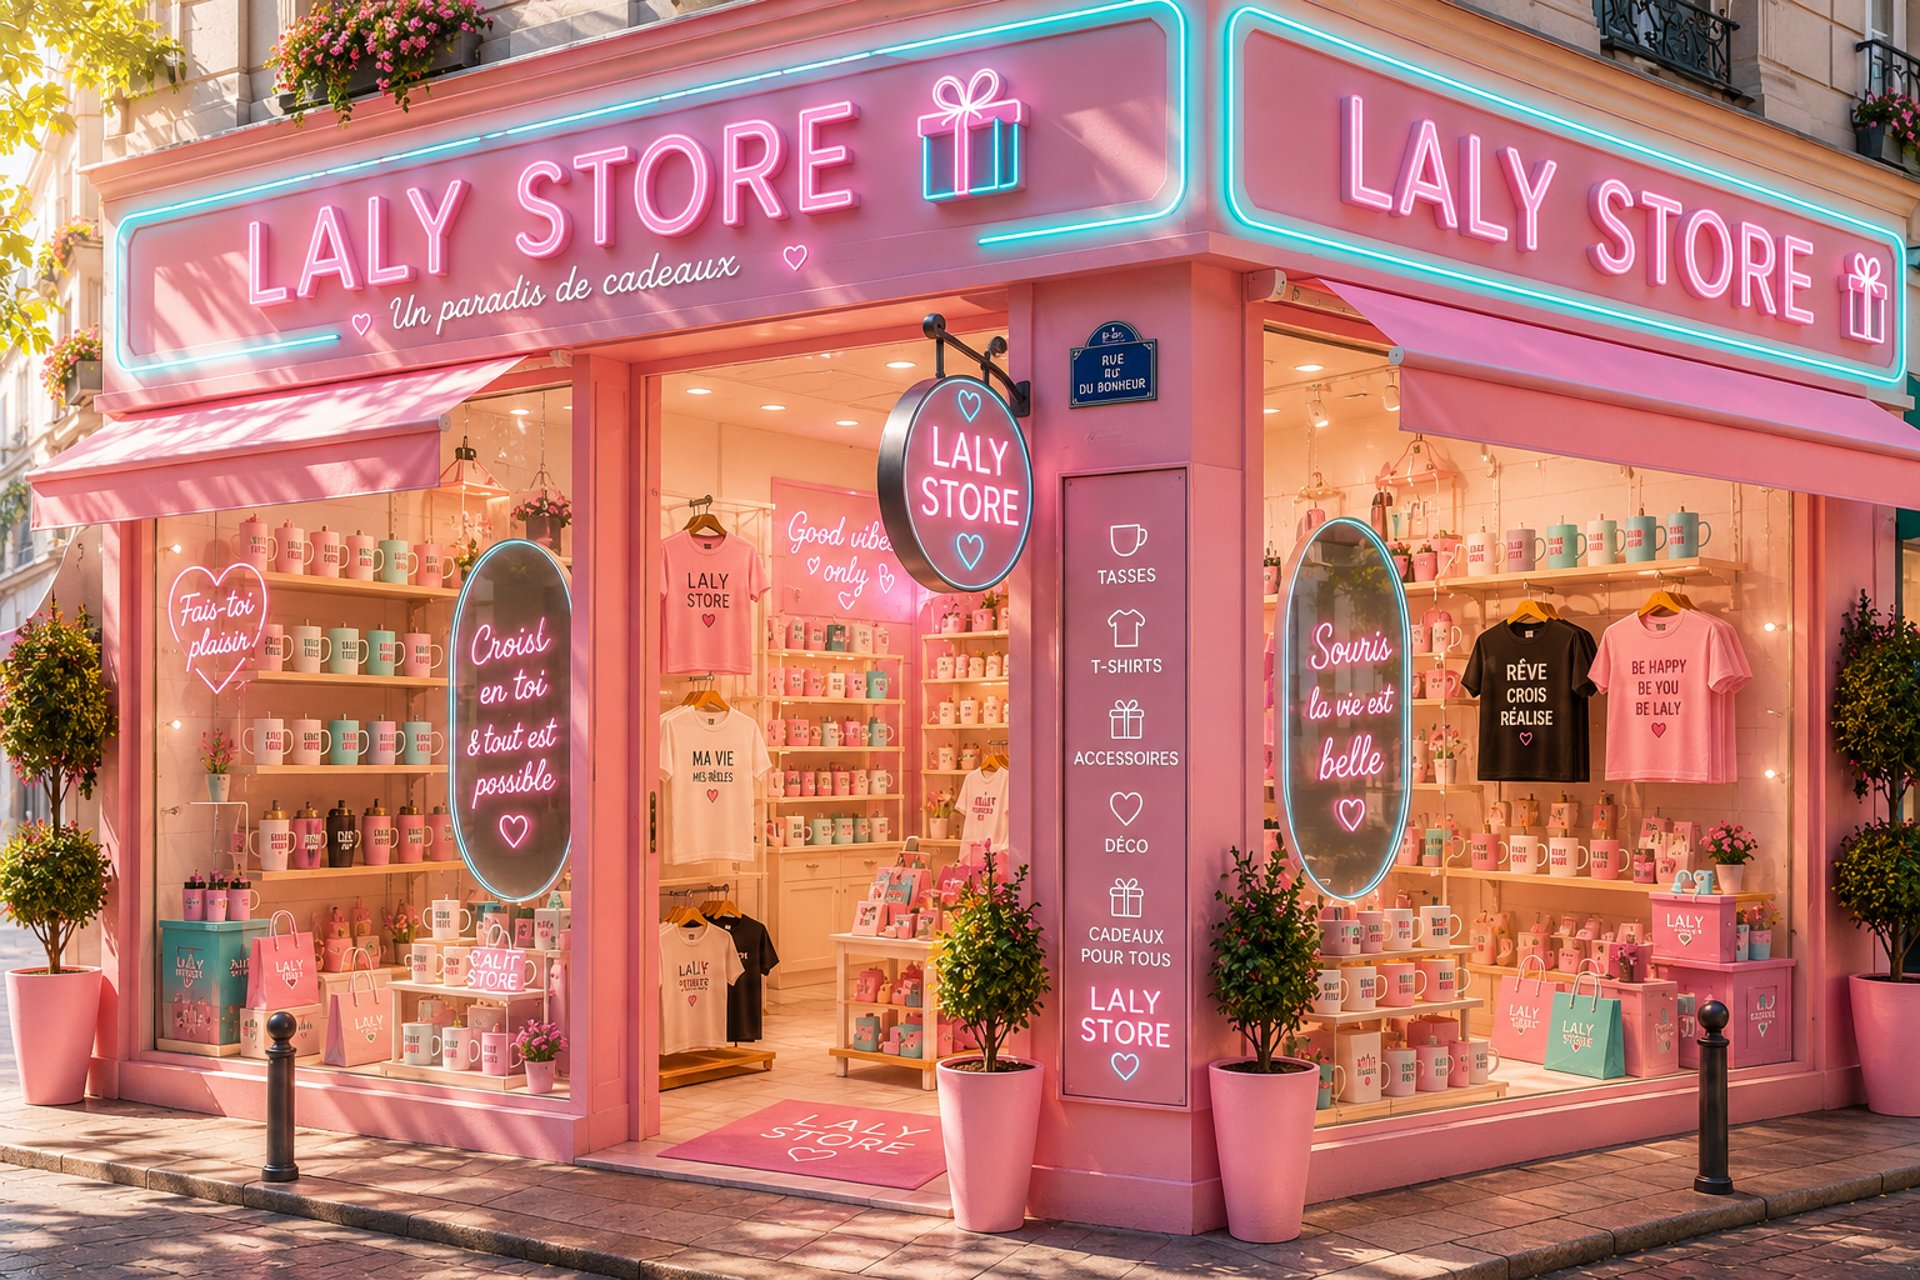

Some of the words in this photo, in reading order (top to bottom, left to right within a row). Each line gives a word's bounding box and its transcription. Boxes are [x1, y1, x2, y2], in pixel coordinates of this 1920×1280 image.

[248, 179, 470, 306] LALY
[515, 100, 859, 260] STORE
[1341, 94, 1556, 252] LALY
[1587, 179, 1814, 325] STORE
[389, 295, 431, 331] Un
[435, 275, 546, 335] paradis
[555, 266, 592, 303] de
[602, 253, 740, 295] cadeaux
[1101, 353, 1125, 367] RUE
[1079, 383, 1094, 395] DU
[1097, 377, 1146, 394] BONHEUR
[932, 425, 1009, 477] LALY
[920, 476, 1020, 527] STORE
[787, 510, 846, 555] Good
[687, 572, 730, 591] LALY
[823, 555, 870, 598] only
[1097, 567, 1157, 585] TASSES
[179, 589, 256, 627] Fais-toi
[687, 593, 730, 609] STORE
[185, 627, 251, 673] plaisir
[1310, 622, 1393, 670] Souris
[1091, 658, 1163, 674] T-SHIRTS
[1506, 658, 1548, 681] RÊVE
[1631, 660, 1646, 675] BE
[1649, 658, 1687, 675] HAPPY
[480, 681, 508, 705] en
[513, 668, 549, 699] toi
[1506, 686, 1547, 704] CROIS
[1637, 680, 1652, 696] BE
[1655, 680, 1679, 695] YOU
[1308, 685, 1332, 720] la
[1336, 691, 1365, 717] vie
[1367, 684, 1395, 716] est
[1635, 701, 1650, 716] BE
[1652, 701, 1682, 716] LALY
[1500, 706, 1554, 726] RÉALISE
[467, 728, 481, 757] &
[484, 721, 524, 754] tout
[527, 717, 558, 750] est
[692, 750, 712, 767] MA
[715, 750, 734, 766] VIE
[1073, 751, 1179, 767] ACCESSOIRES
[1319, 734, 1385, 781] belle
[472, 758, 557, 810] possible
[1104, 835, 1149, 854] DÉCO
[1666, 913, 1705, 929] LALY
[1088, 926, 1165, 945] CADEAUX
[275, 959, 304, 973] LALY
[1081, 948, 1124, 966] POUR
[1128, 951, 1172, 968] TOUS
[466, 969, 518, 991] STORE
[1090, 985, 1161, 1015] LALY
[354, 1015, 384, 1030] LALY
[1508, 1004, 1540, 1020] LALY
[1080, 1017, 1171, 1049] STORE
[1561, 1020, 1595, 1037] LALY
[794, 1113, 932, 1140] LALY
[759, 1126, 916, 1156] STORE
